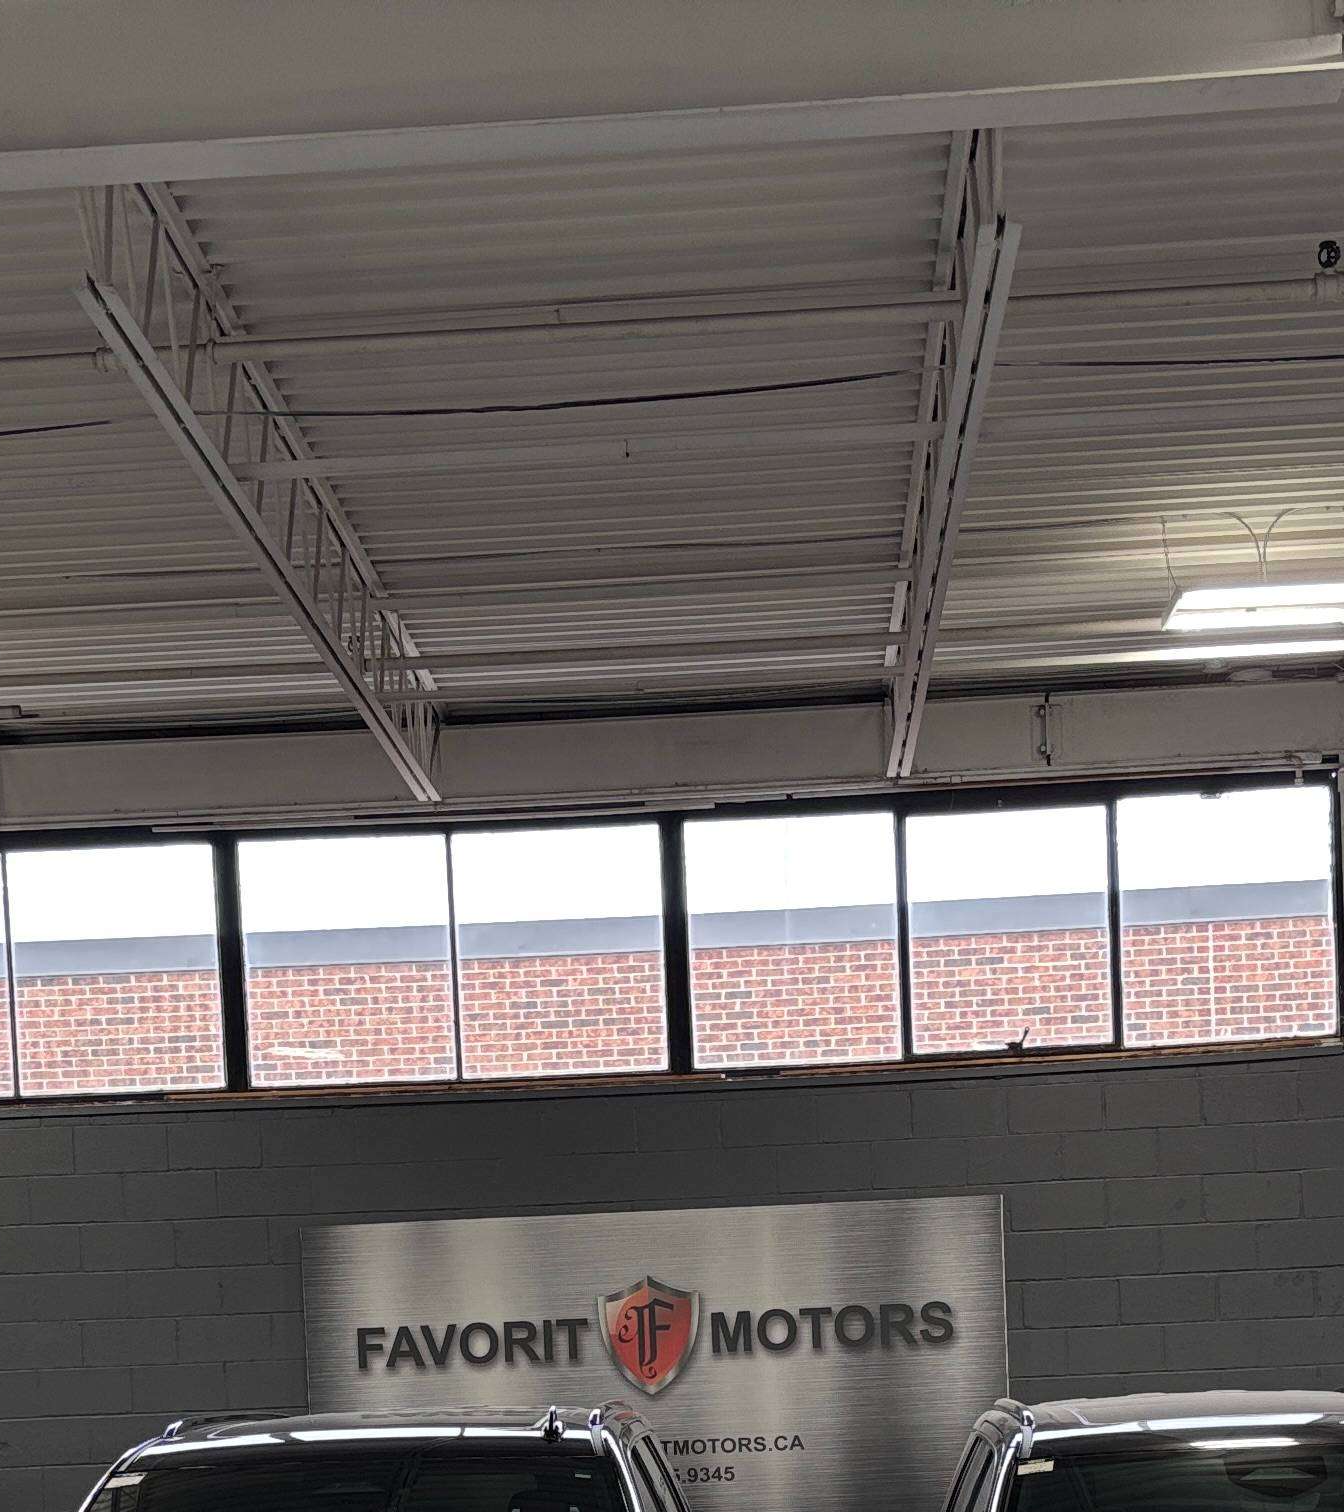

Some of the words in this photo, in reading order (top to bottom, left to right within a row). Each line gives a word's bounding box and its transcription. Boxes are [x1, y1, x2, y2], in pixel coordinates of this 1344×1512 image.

[357, 1318, 589, 1369] FAVORIT
[710, 1301, 954, 1354] MOTORS
[659, 1434, 806, 1457] TMOTORS.CA
[673, 1465, 736, 1483] .9345
